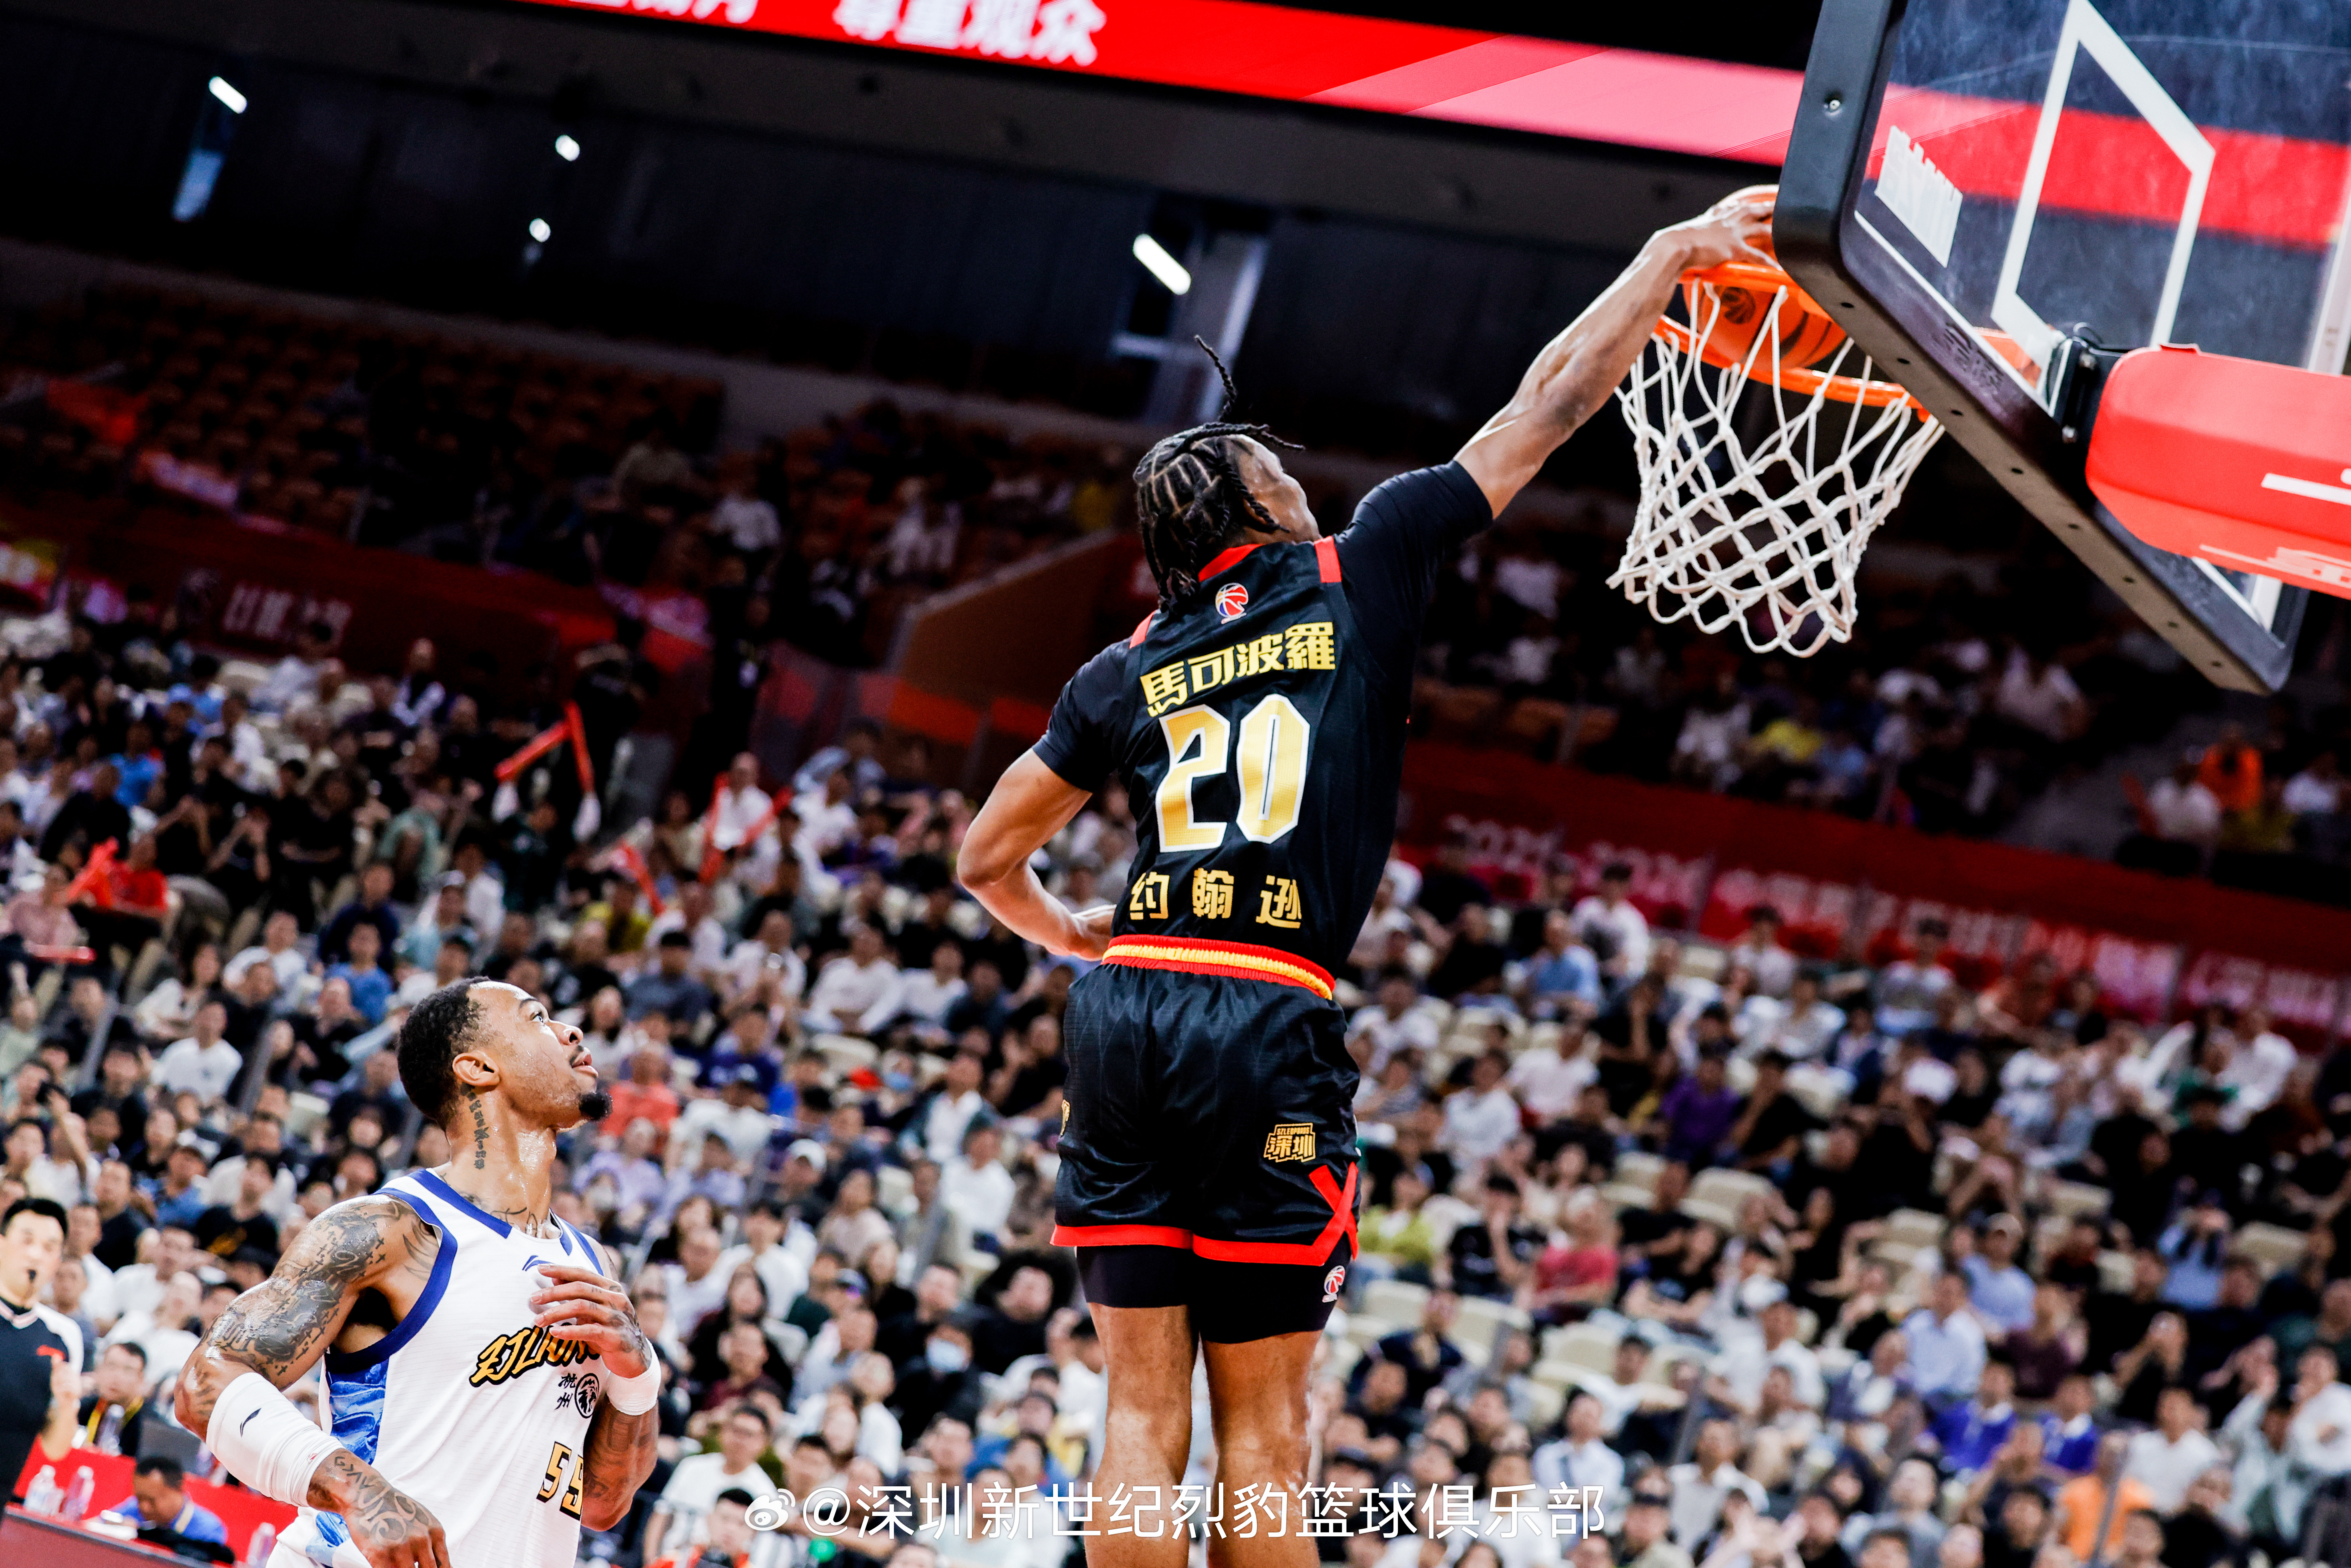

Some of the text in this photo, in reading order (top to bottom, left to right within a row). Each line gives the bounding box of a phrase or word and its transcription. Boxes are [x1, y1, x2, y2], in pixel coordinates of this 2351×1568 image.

[1140, 622, 1336, 717] 馬可波羅
[1156, 693, 1310, 853] 20
[1267, 1134, 1313, 1158] 深圳
[469, 1322, 600, 1387] ZJLION
